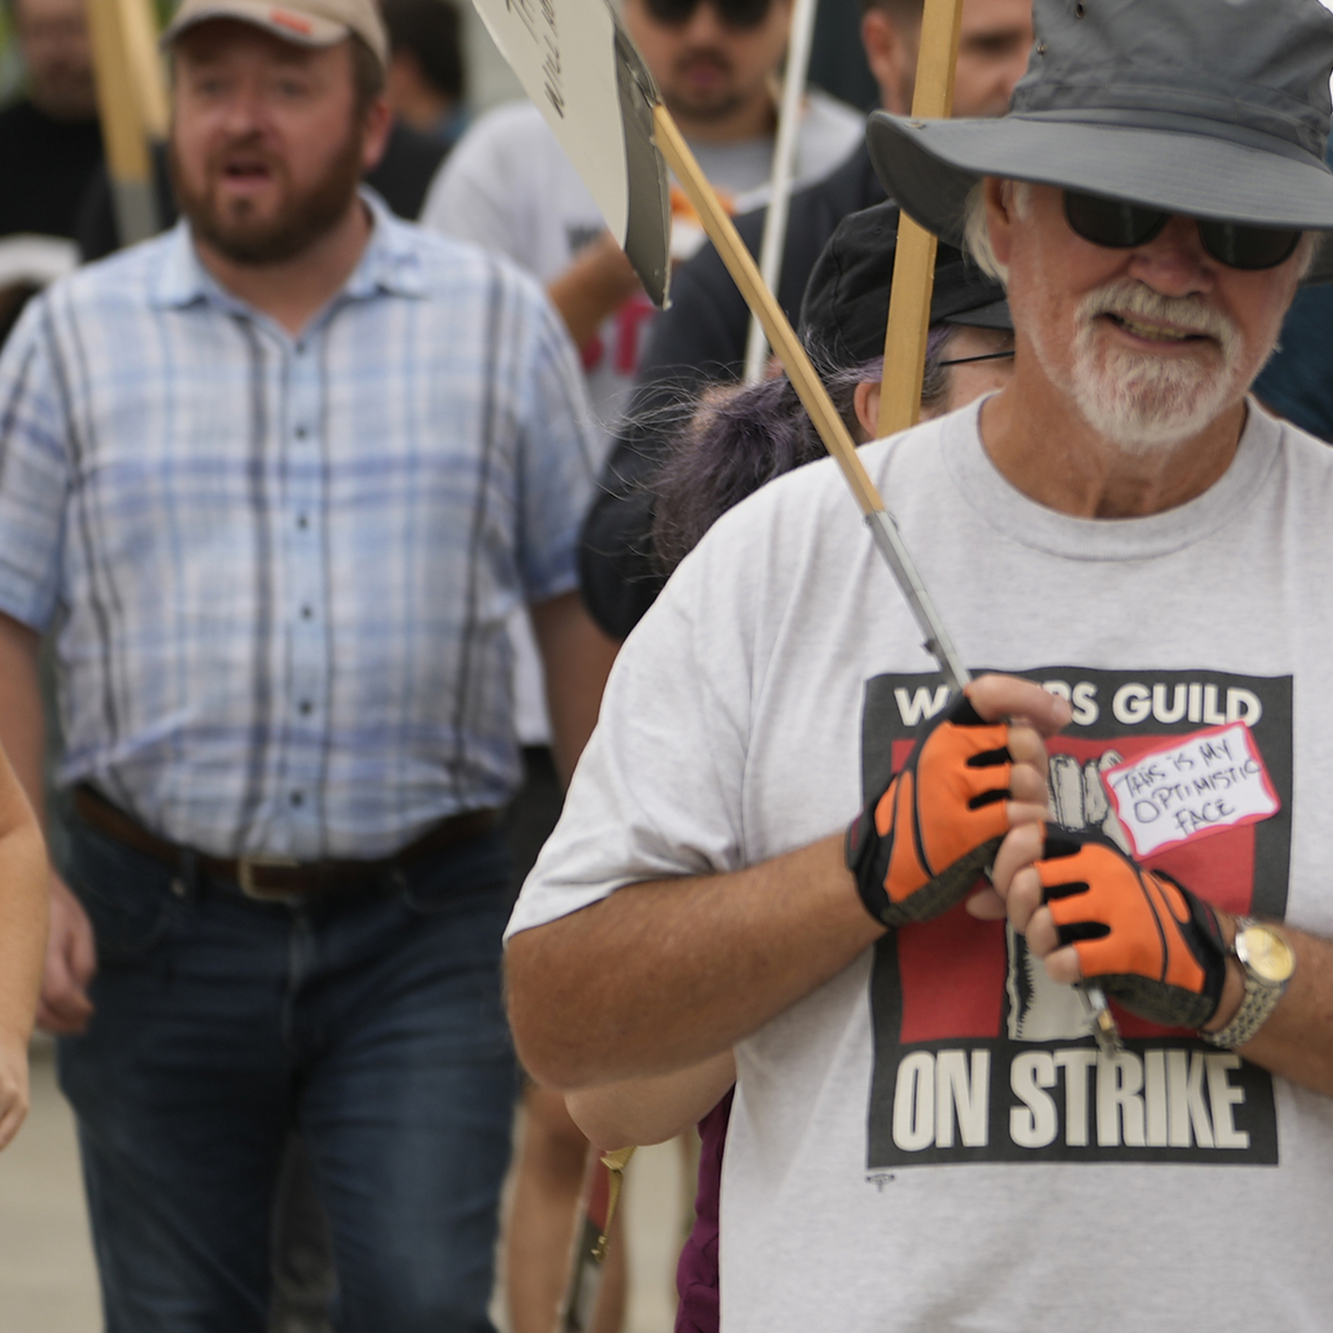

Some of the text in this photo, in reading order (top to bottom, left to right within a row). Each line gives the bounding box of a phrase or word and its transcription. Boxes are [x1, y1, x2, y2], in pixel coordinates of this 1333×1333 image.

[1112, 682, 1263, 728] GUILD
[1200, 738, 1233, 768] MY
[1174, 798, 1236, 837] FACE
[892, 1049, 1251, 1151] ON STRIKE
